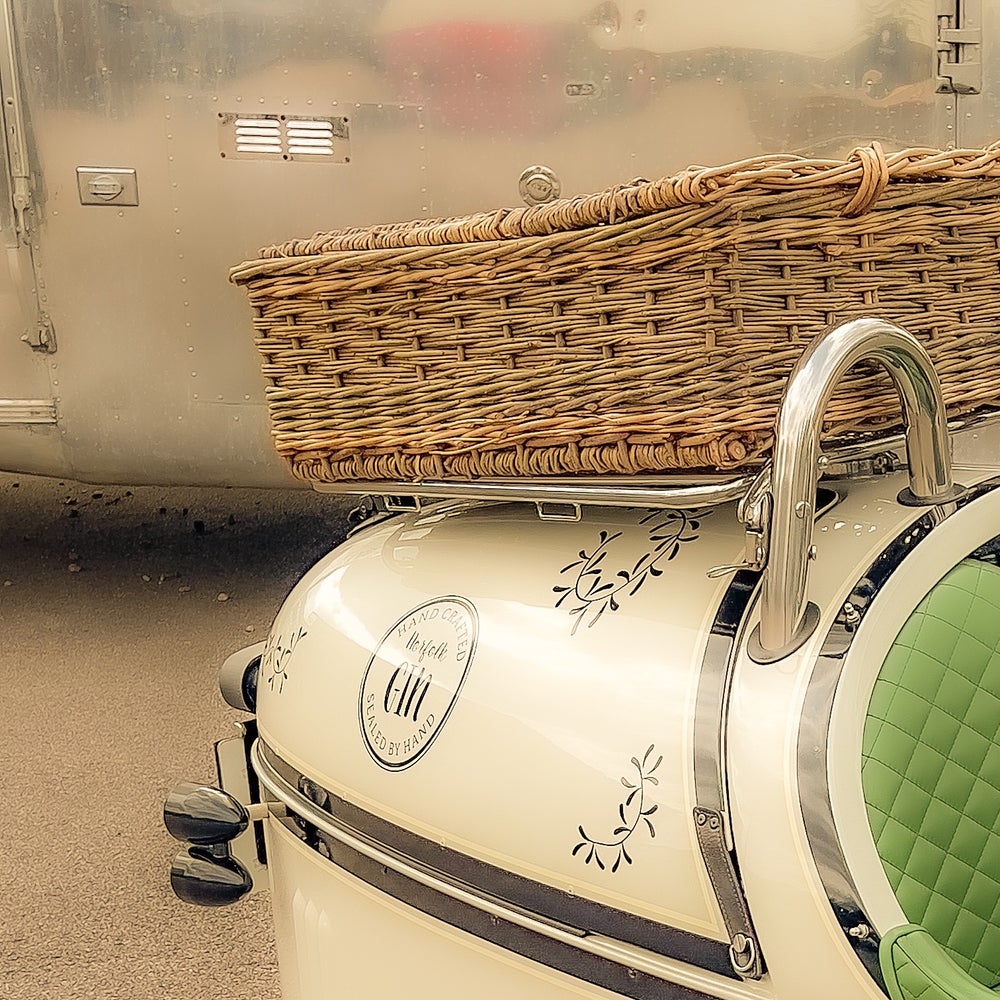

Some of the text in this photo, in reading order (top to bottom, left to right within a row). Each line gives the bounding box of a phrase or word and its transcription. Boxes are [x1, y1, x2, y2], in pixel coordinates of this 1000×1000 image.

[398, 607, 468, 661] HAND CRAFTED
[406, 631, 447, 662] Norfolk
[384, 662, 432, 721] GIN
[366, 693, 434, 755] SEALED BY HAND
